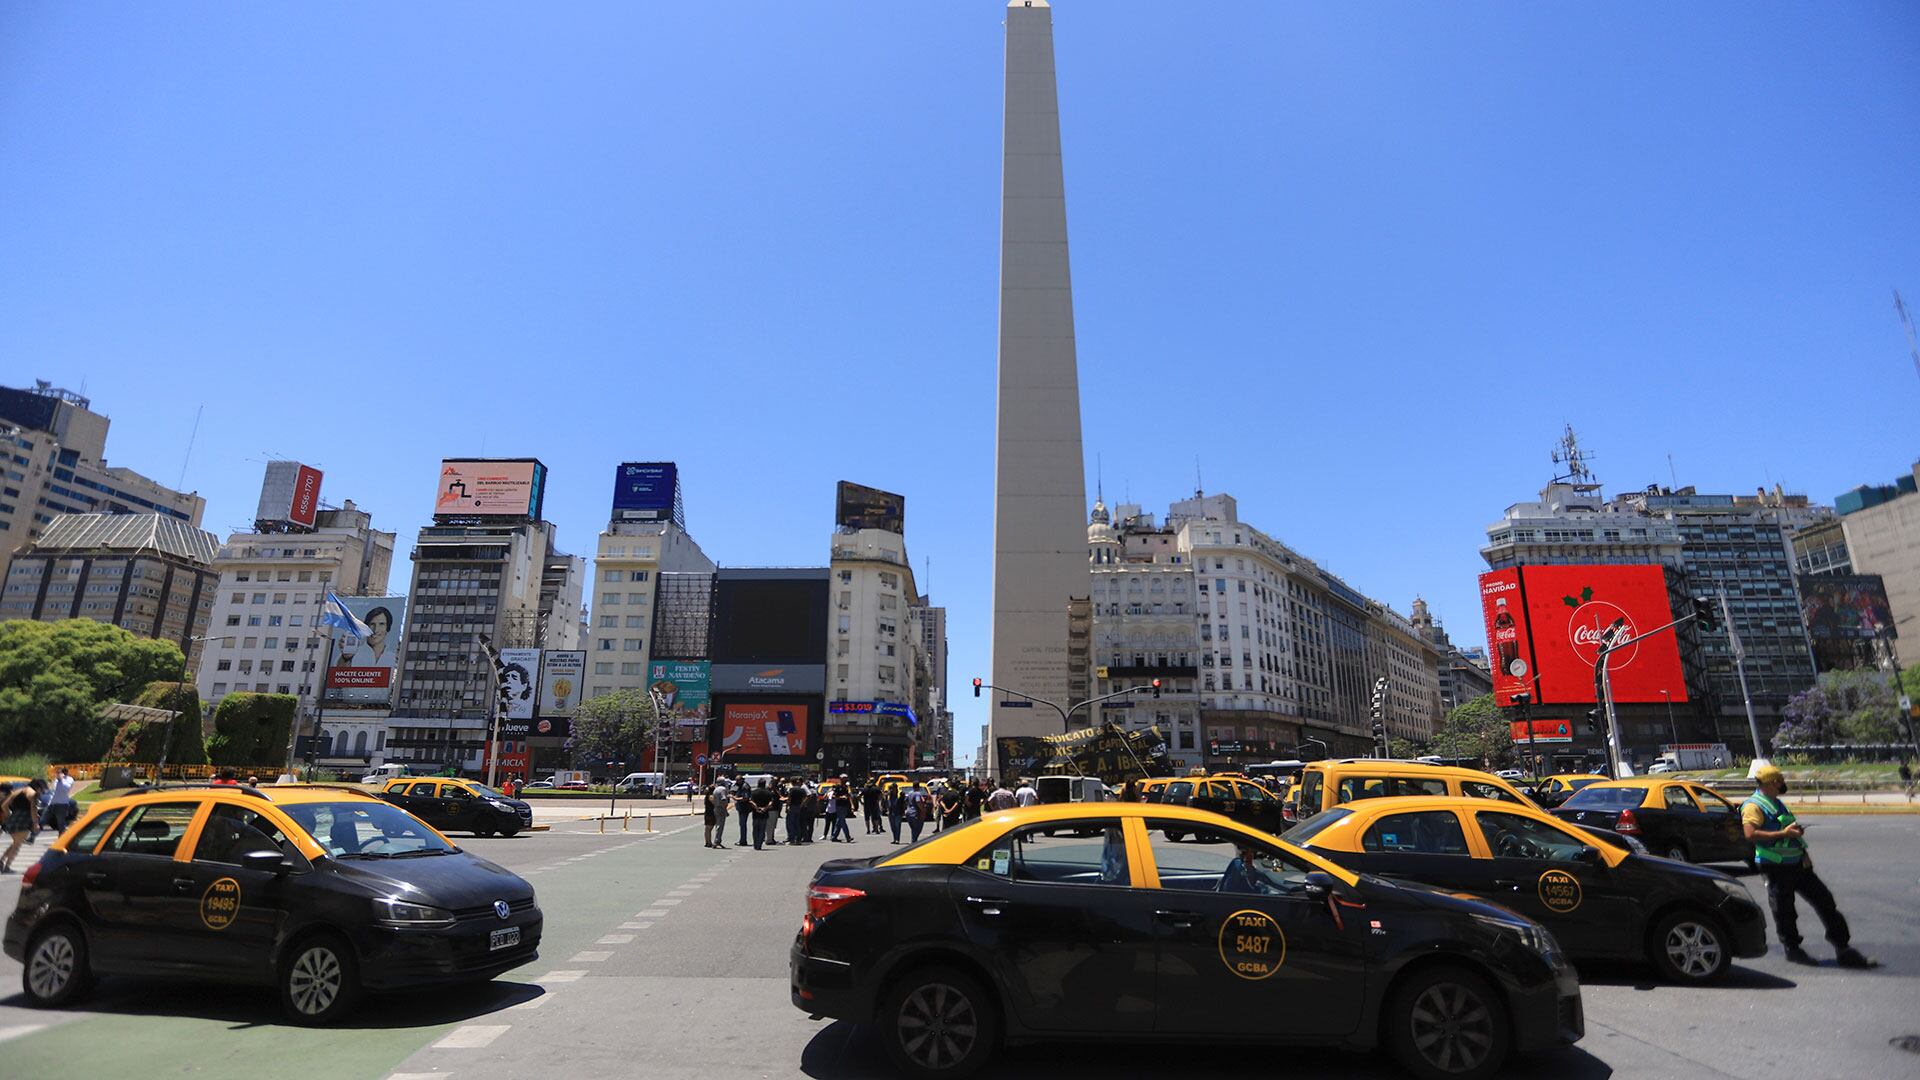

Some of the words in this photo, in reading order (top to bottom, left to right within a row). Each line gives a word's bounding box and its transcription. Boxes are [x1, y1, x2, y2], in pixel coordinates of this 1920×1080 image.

[300, 474, 315, 516] 4556-1701
[1483, 583, 1516, 595] NAVIDAD
[844, 703, 872, 711] $3.019
[1043, 744, 1074, 759] TAXIS
[485, 758, 524, 767] PIMICIA
[215, 884, 235, 892] TAXI
[1548, 897, 1573, 905] GCBA
[1237, 916, 1267, 927] TAXI
[1236, 935, 1270, 953] 5487
[1237, 962, 1268, 973] GCBA
